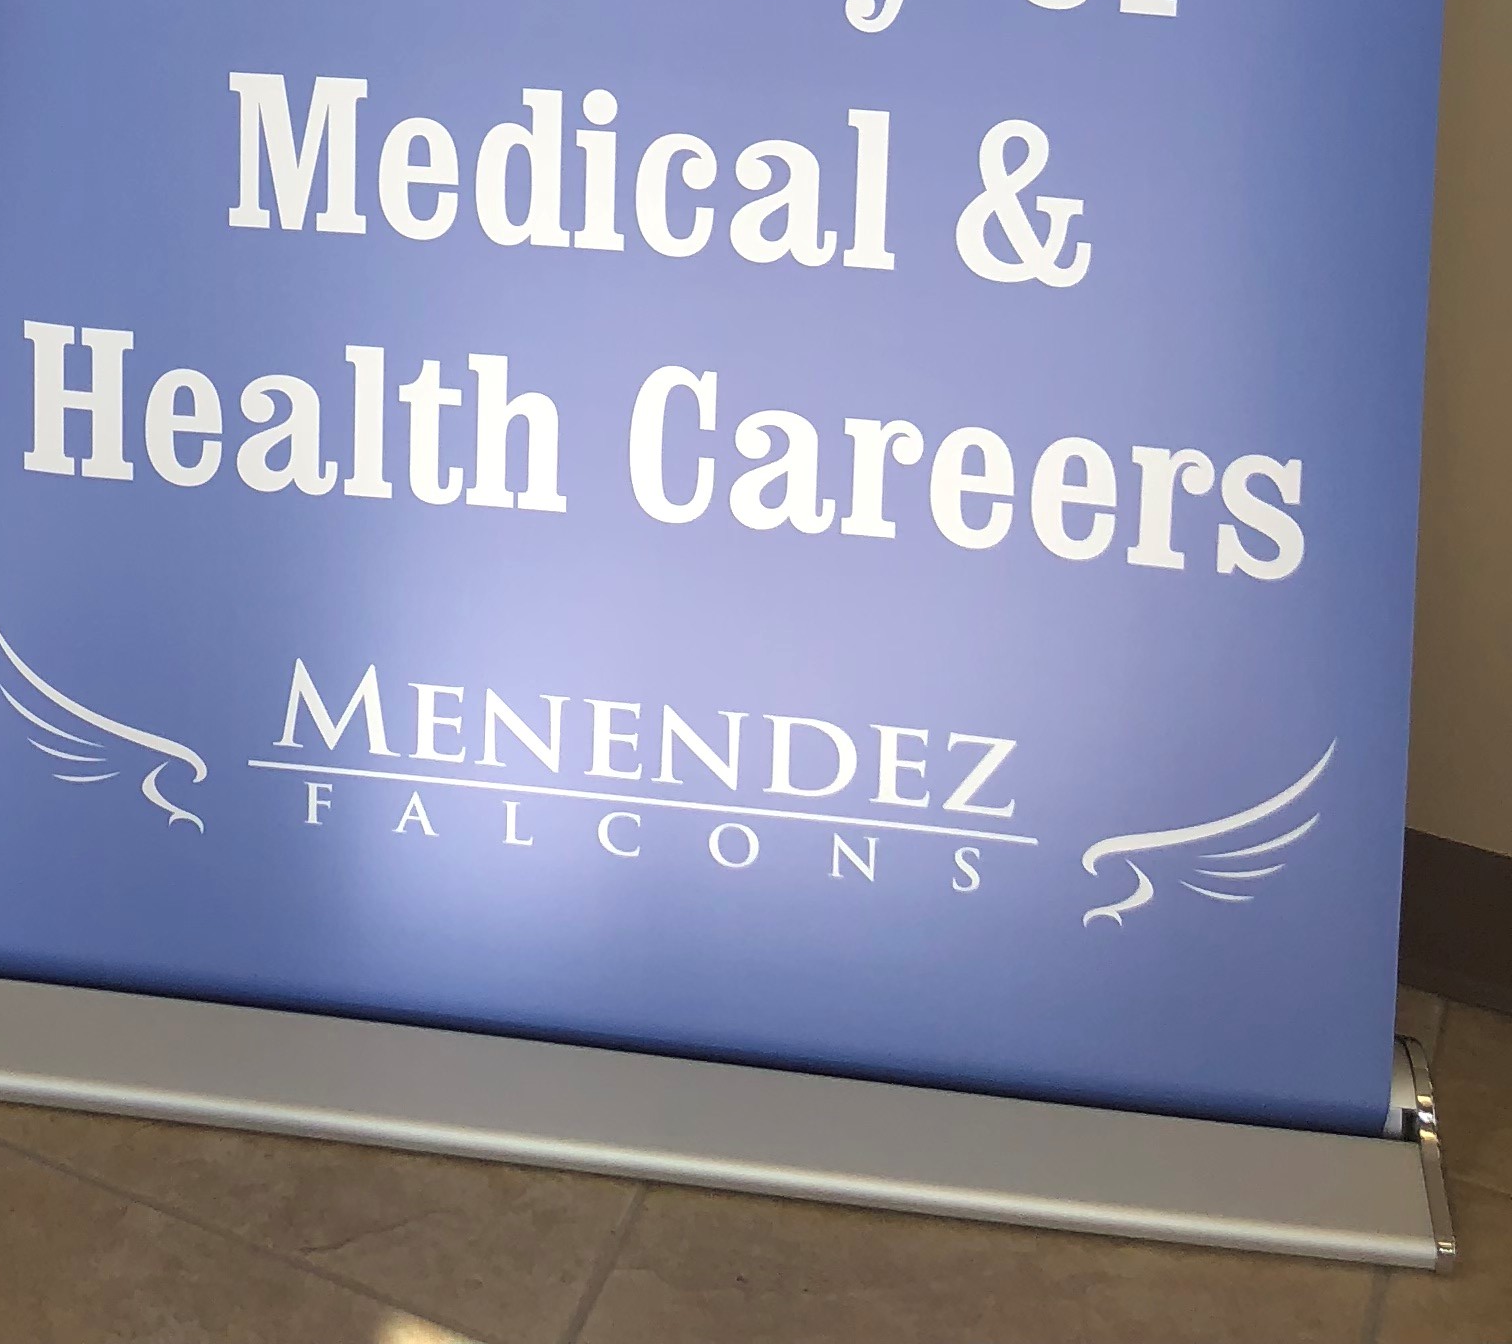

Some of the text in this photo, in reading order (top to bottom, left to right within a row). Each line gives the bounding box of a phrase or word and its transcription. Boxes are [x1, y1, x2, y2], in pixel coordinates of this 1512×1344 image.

[228, 71, 1093, 288] Medical &
[23, 319, 1305, 581] Health Careers
[274, 658, 1019, 819] MENENDEZ
[307, 782, 981, 892] FALCONS
